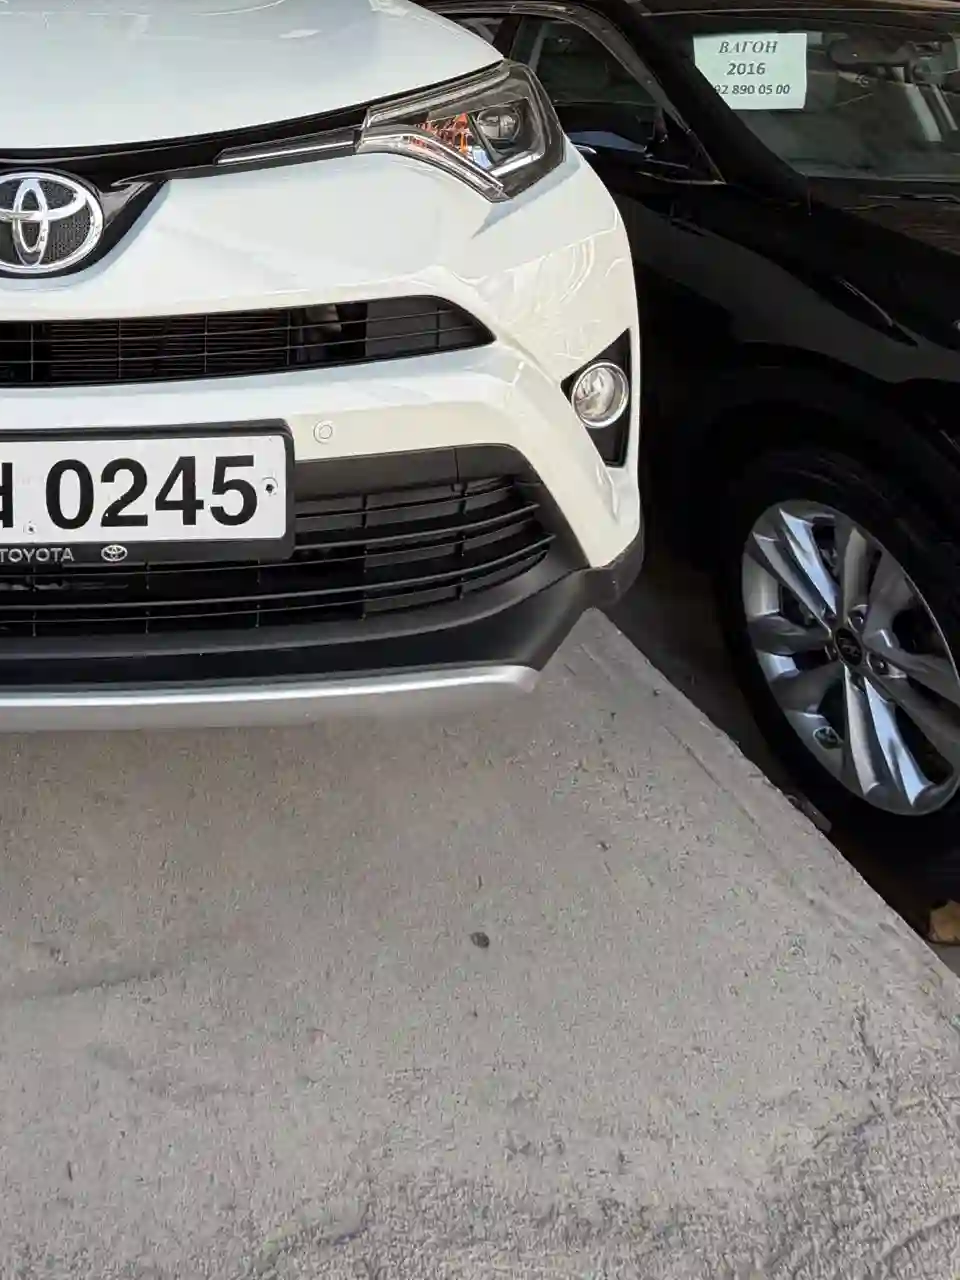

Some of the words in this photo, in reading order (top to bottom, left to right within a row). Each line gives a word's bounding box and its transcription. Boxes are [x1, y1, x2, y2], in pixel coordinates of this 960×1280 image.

[718, 40, 778, 54] ВАГОН
[726, 62, 766, 76] 2016
[731, 84, 755, 95] 890
[758, 84, 773, 95] 05
[775, 84, 791, 95] 00
[44, 455, 259, 531] 0245
